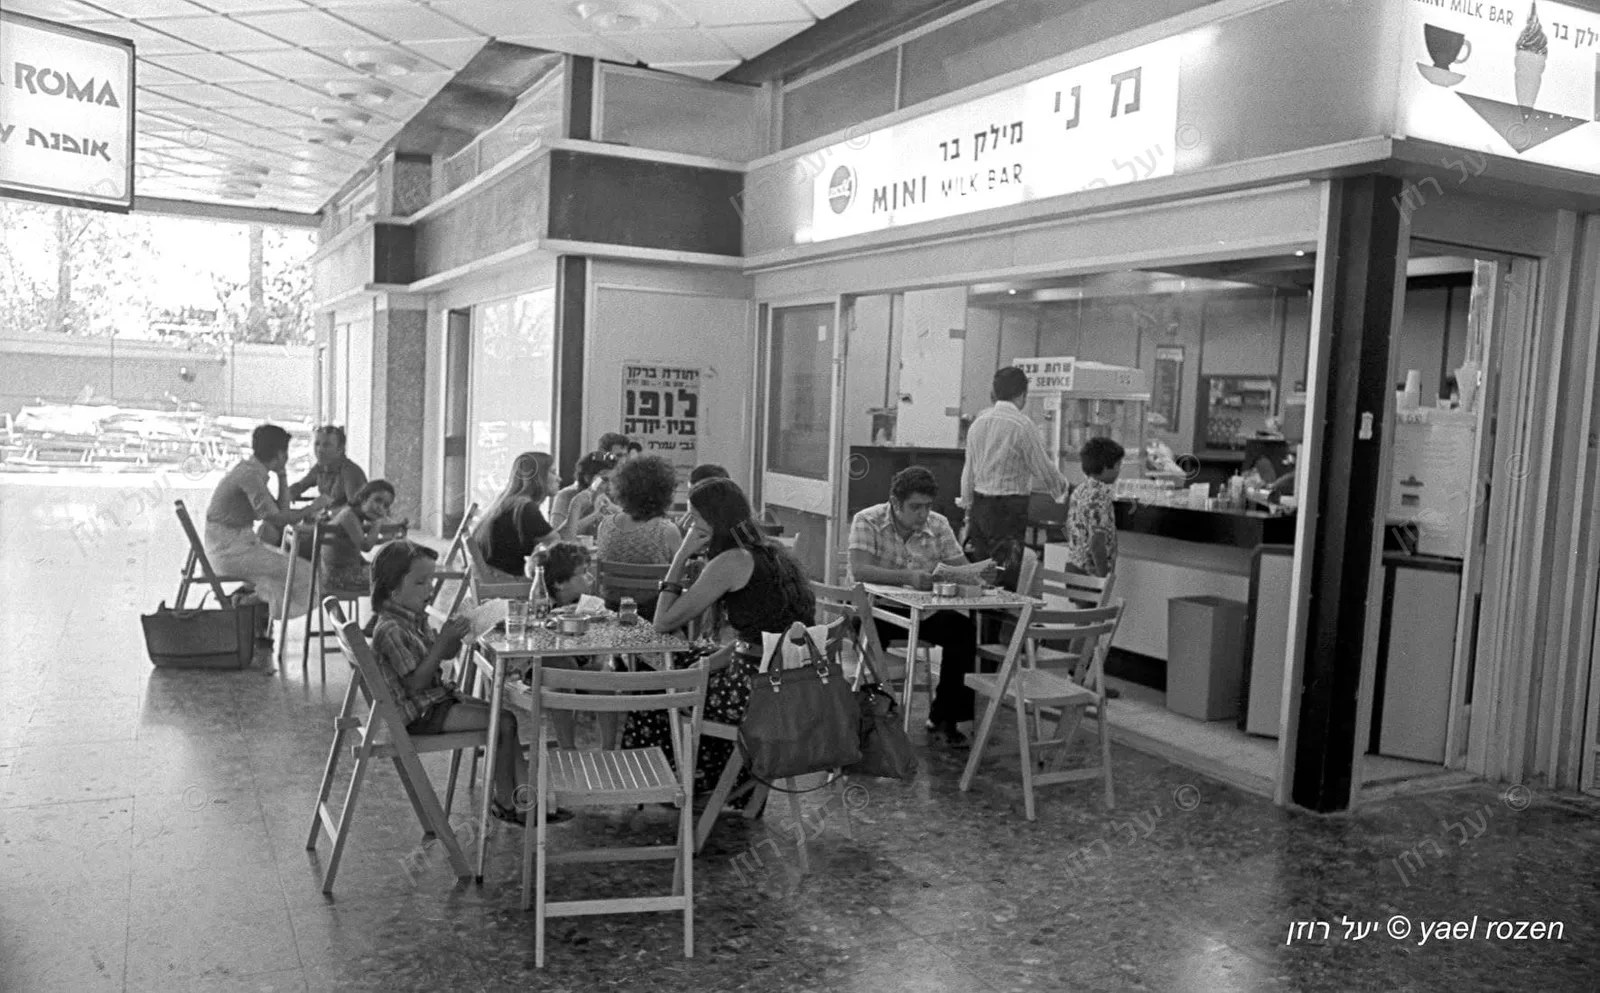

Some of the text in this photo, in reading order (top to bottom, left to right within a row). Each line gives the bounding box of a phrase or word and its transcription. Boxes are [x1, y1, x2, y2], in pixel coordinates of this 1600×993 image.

[1450, 0, 1483, 18] MILK
[1489, 6, 1514, 26] BAR
[1552, 22, 1569, 40] בר
[14, 62, 121, 109] ROMA
[25, 127, 112, 162] אופנת
[939, 121, 1024, 161] מילק בר
[872, 175, 927, 214] MINI
[941, 173, 978, 197] MILK
[988, 163, 1022, 189] BAR
[627, 366, 699, 380] יהודה ברקן
[626, 388, 697, 418] לופו
